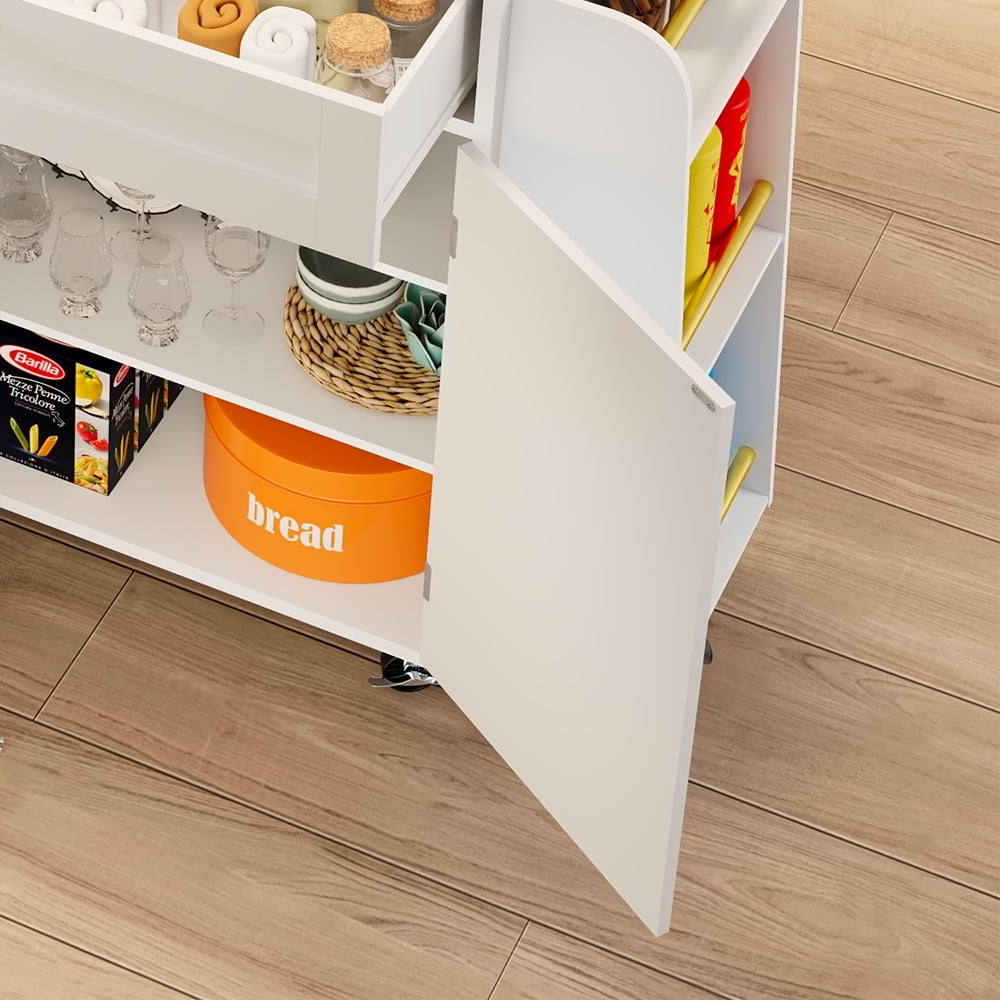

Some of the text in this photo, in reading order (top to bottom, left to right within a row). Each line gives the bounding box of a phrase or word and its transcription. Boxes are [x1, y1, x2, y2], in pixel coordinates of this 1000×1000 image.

[14, 352, 60, 376] Barilla
[8, 385, 56, 411] Tricolore
[34, 383, 69, 404] Penne
[246, 491, 344, 552] bread
